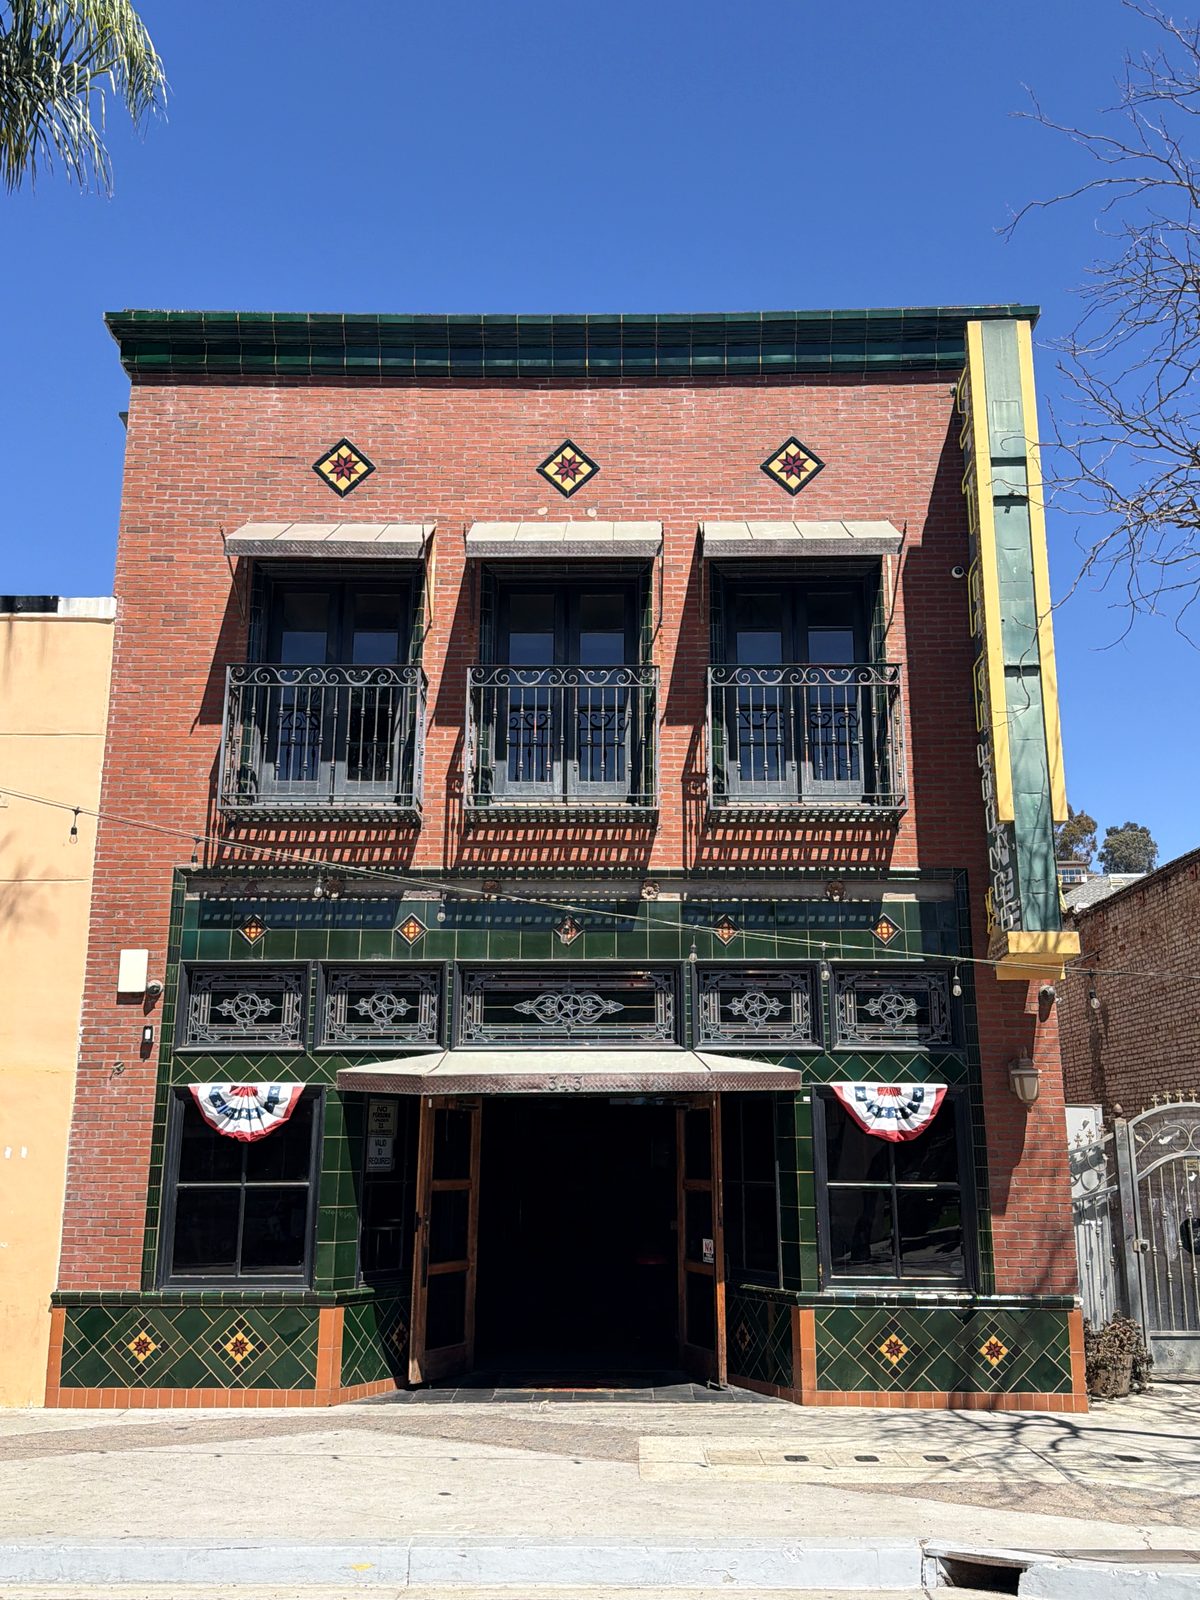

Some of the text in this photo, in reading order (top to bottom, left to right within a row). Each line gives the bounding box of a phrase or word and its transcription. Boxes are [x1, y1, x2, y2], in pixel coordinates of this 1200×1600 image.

[549, 1075, 583, 1091] 343
[374, 1139, 387, 1147] VALID
[368, 1157, 391, 1165] REQUIRED
